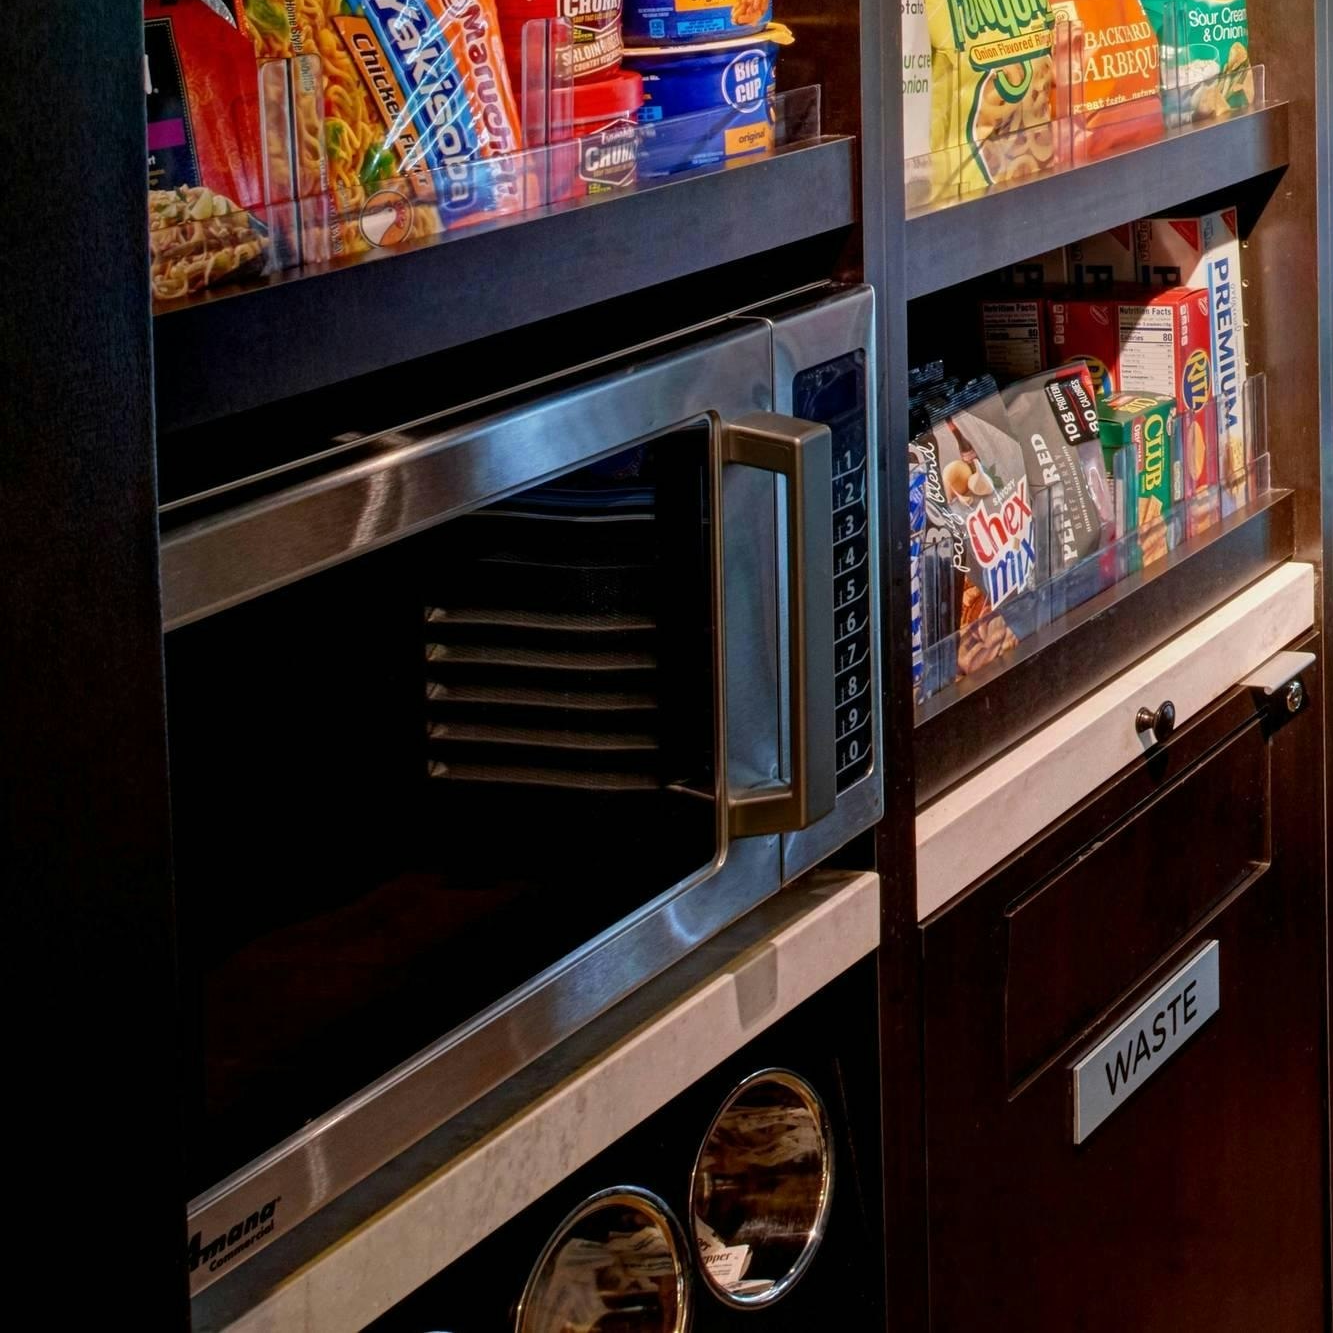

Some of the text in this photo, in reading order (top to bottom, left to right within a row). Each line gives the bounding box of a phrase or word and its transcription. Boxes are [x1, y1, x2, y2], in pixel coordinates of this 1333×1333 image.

[1189, 6, 1247, 28] Sour Cream
[1212, 25, 1243, 41] Onion
[974, 37, 1034, 61] Onion Flavored
[733, 57, 759, 77] BIG
[1071, 44, 1160, 84] BARBEQU
[352, 32, 401, 124] Chicken
[734, 79, 763, 104] CUP
[461, 2, 520, 204] Maruchan
[738, 128, 766, 144] original
[1214, 257, 1238, 429] PREMIUM
[1189, 352, 1211, 412] RITZ
[844, 452, 852, 469] 1
[1145, 414, 1164, 492] CLUB
[845, 484, 855, 502] 2
[845, 516, 855, 534] 3
[968, 480, 1033, 565] Chex
[846, 549, 856, 567] 4
[991, 532, 1036, 605] mix
[846, 581, 857, 599] 5
[847, 615, 857, 633] 6
[847, 647, 858, 664] 7
[848, 679, 858, 697] 8
[848, 710, 859, 728] 9
[849, 743, 859, 761] 0
[1105, 979, 1198, 1096] WASTE
[209, 1218, 275, 1273] commercial
